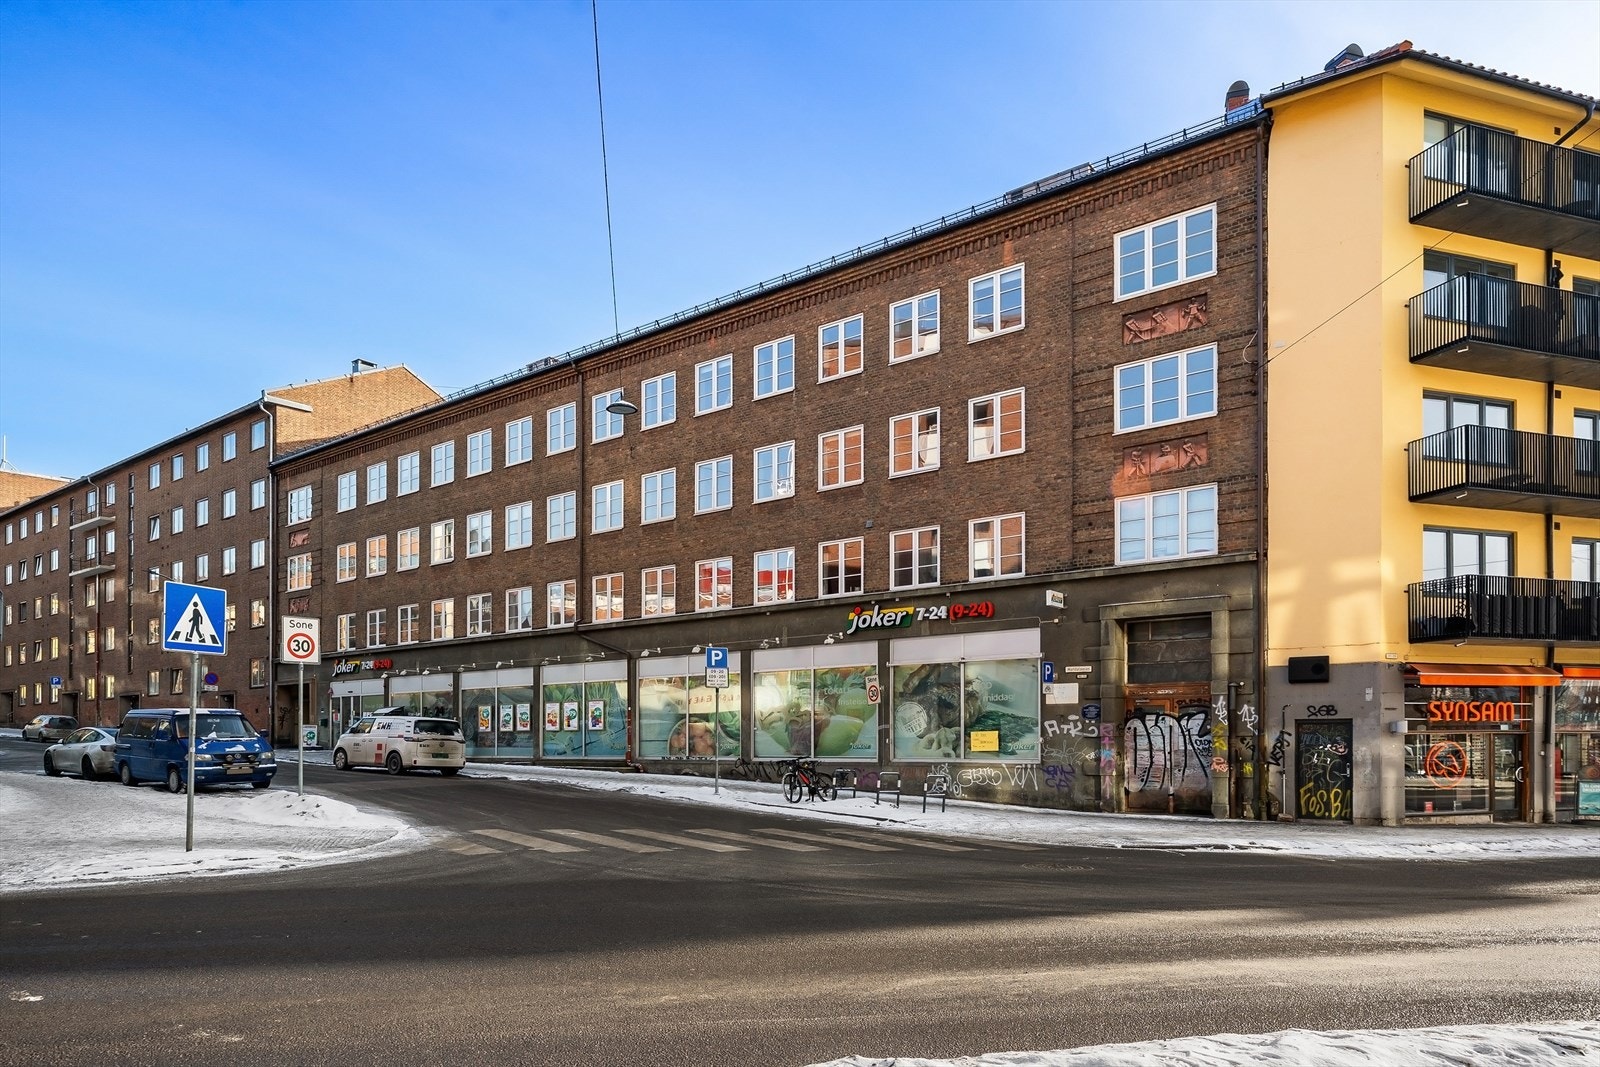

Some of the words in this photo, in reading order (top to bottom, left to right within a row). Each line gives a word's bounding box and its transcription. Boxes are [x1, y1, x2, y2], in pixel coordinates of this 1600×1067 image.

[289, 619, 313, 630] Sone
[847, 605, 909, 635] joker
[916, 605, 948, 621] 7-24
[949, 601, 994, 621] (9-24)
[292, 639, 311, 653] 30
[711, 649, 723, 666] P
[332, 659, 356, 677] joker
[1045, 664, 1052, 681] P
[1428, 700, 1516, 723] SYNSAM
[1007, 741, 1032, 753] joker
